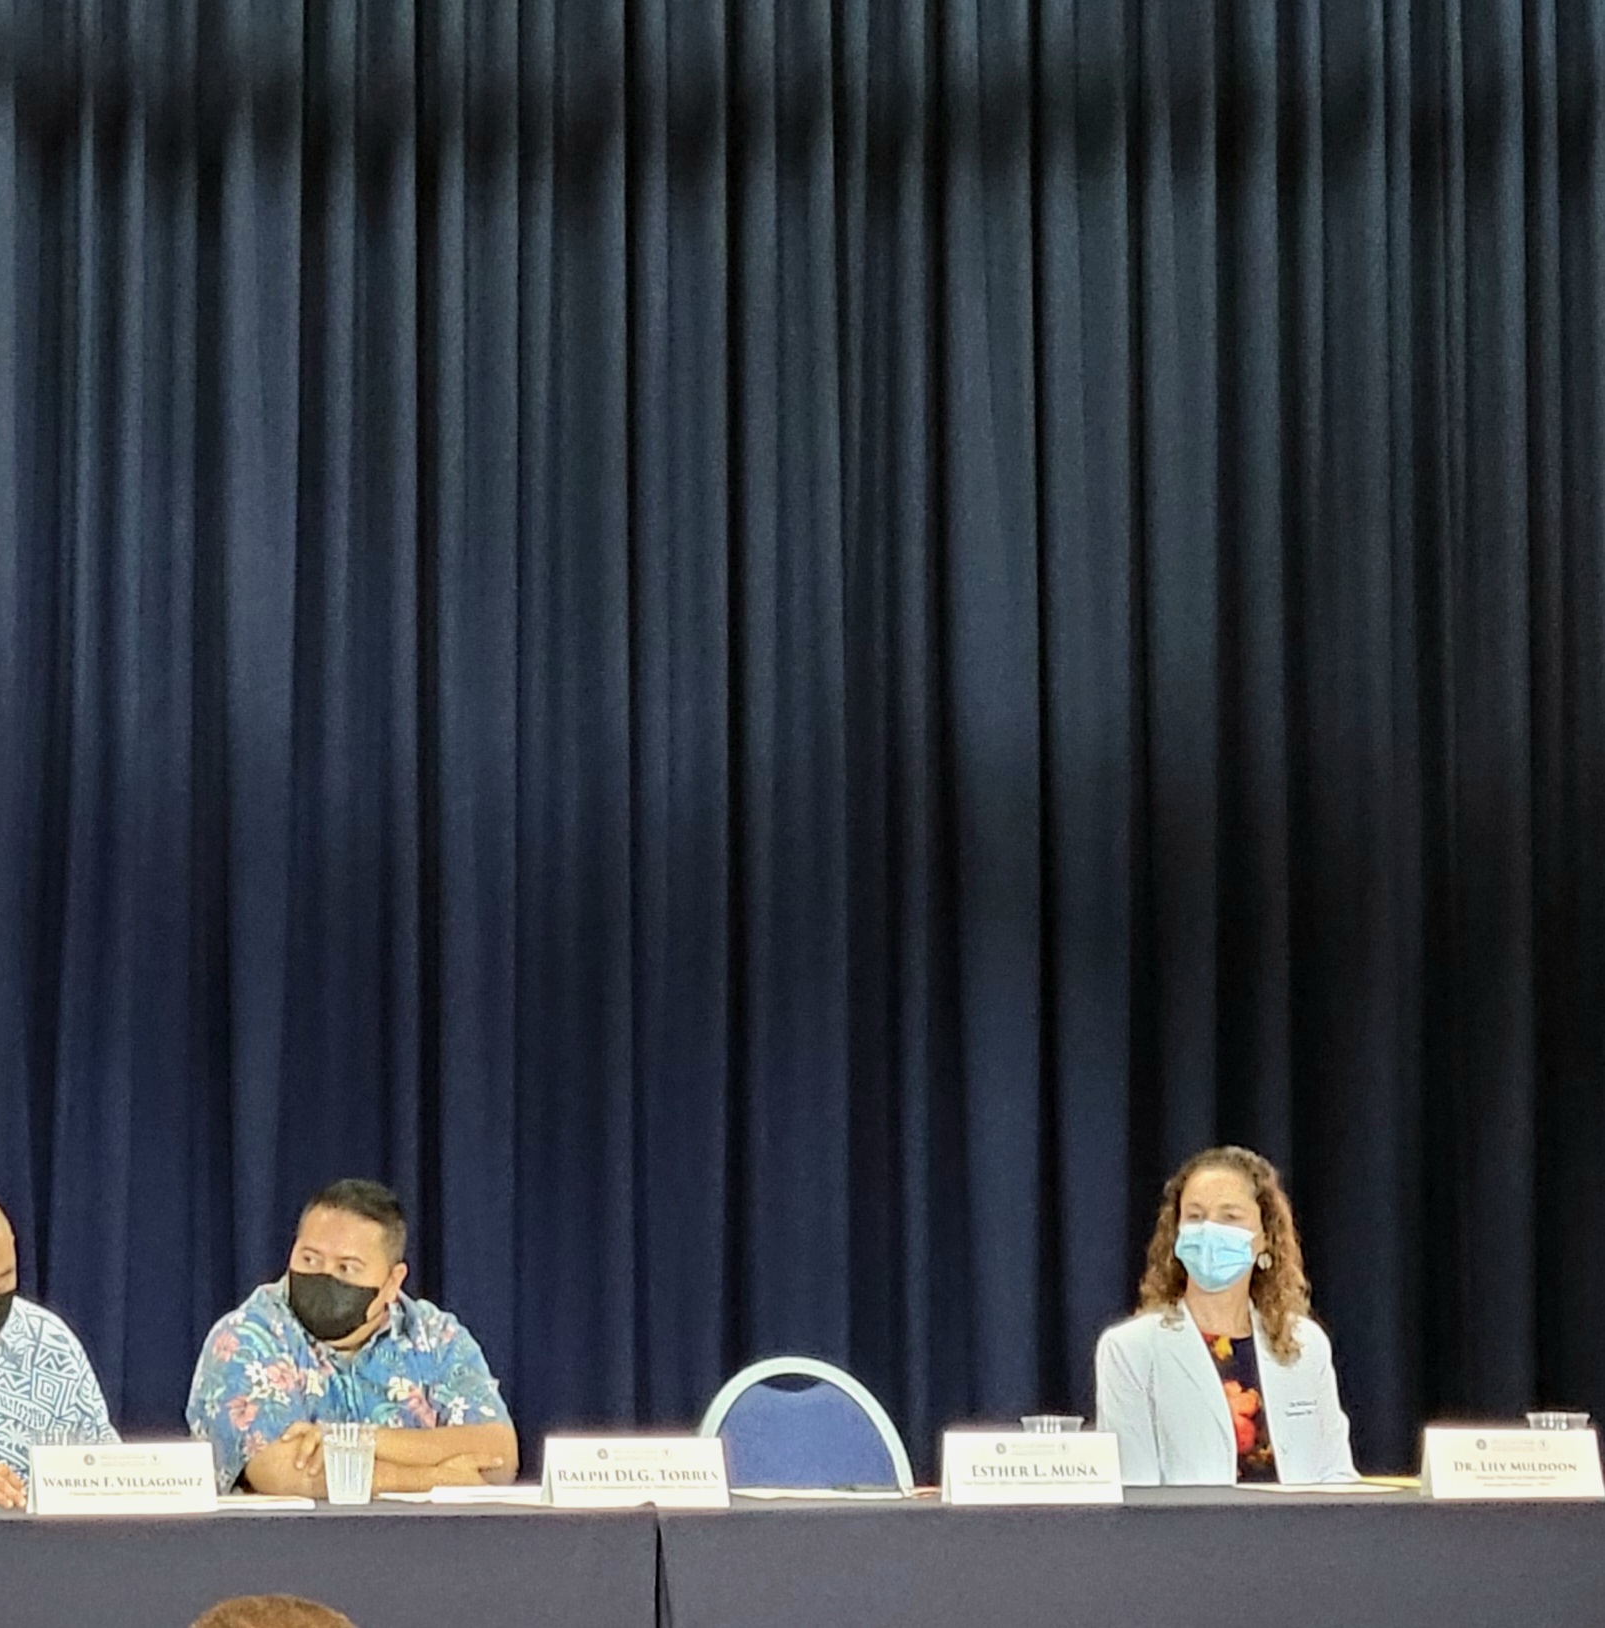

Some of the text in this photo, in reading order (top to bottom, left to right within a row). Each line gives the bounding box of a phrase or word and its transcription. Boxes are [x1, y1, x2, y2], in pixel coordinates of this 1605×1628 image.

[972, 1462, 1099, 1478] ESTHER L. MUÑA
[1454, 1461, 1578, 1472] DR. LILY MULDOON
[558, 1469, 718, 1482] RALPH DLG. TORRES
[43, 1477, 99, 1488] WARREN
[117, 1476, 203, 1488] VILLAGOMEZ
